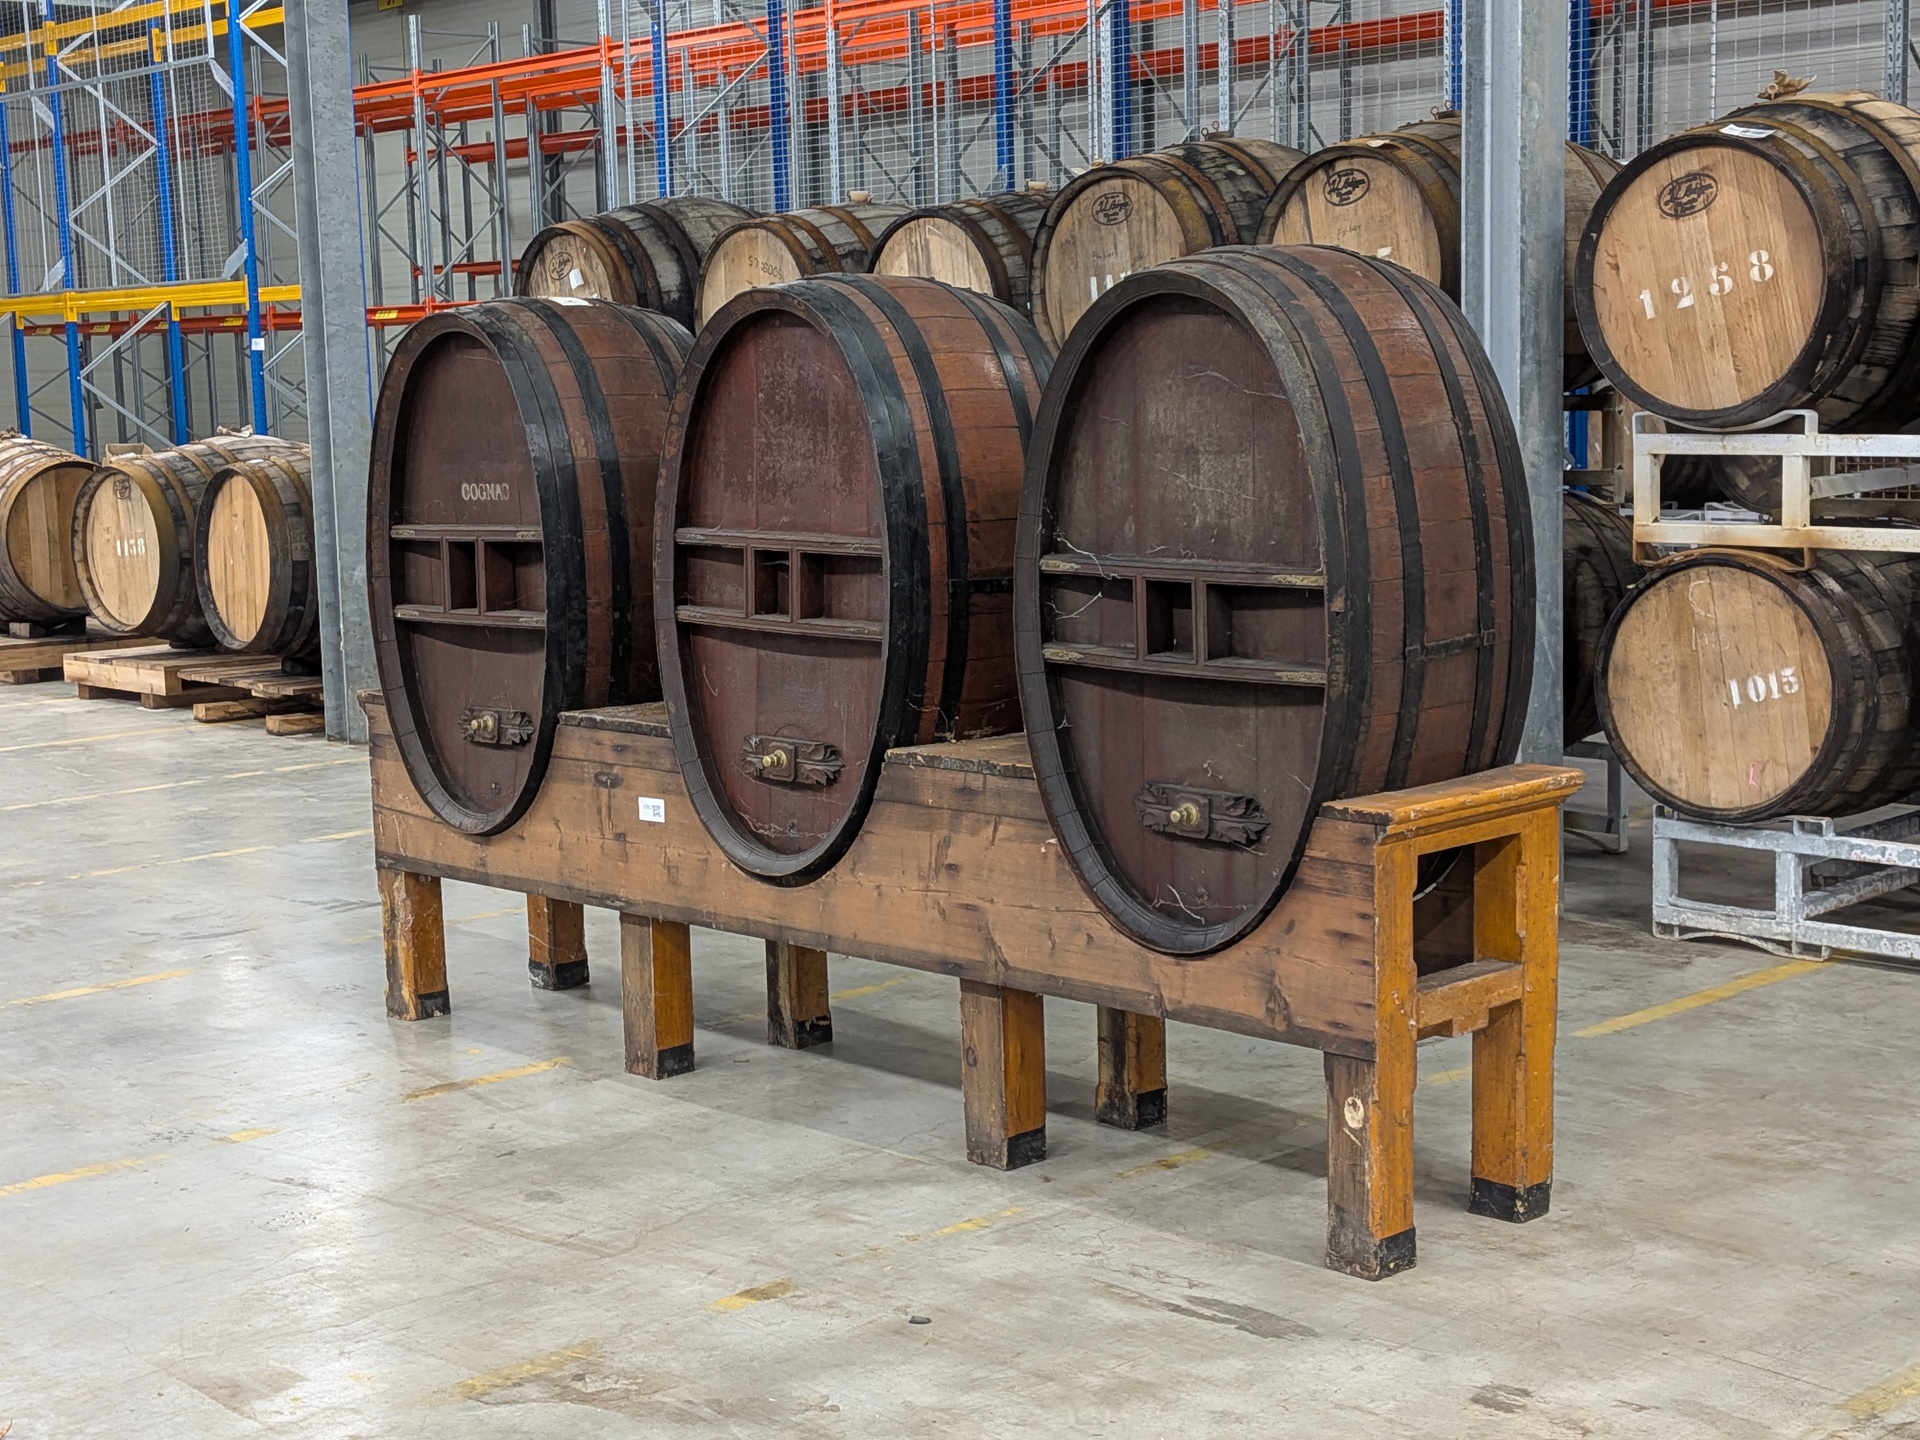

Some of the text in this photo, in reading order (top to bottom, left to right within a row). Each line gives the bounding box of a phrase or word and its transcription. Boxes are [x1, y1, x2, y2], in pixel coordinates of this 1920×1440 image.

[1636, 249, 1775, 321] 1258
[461, 483, 510, 501] COGNAC
[1728, 666, 1799, 709] 1015
